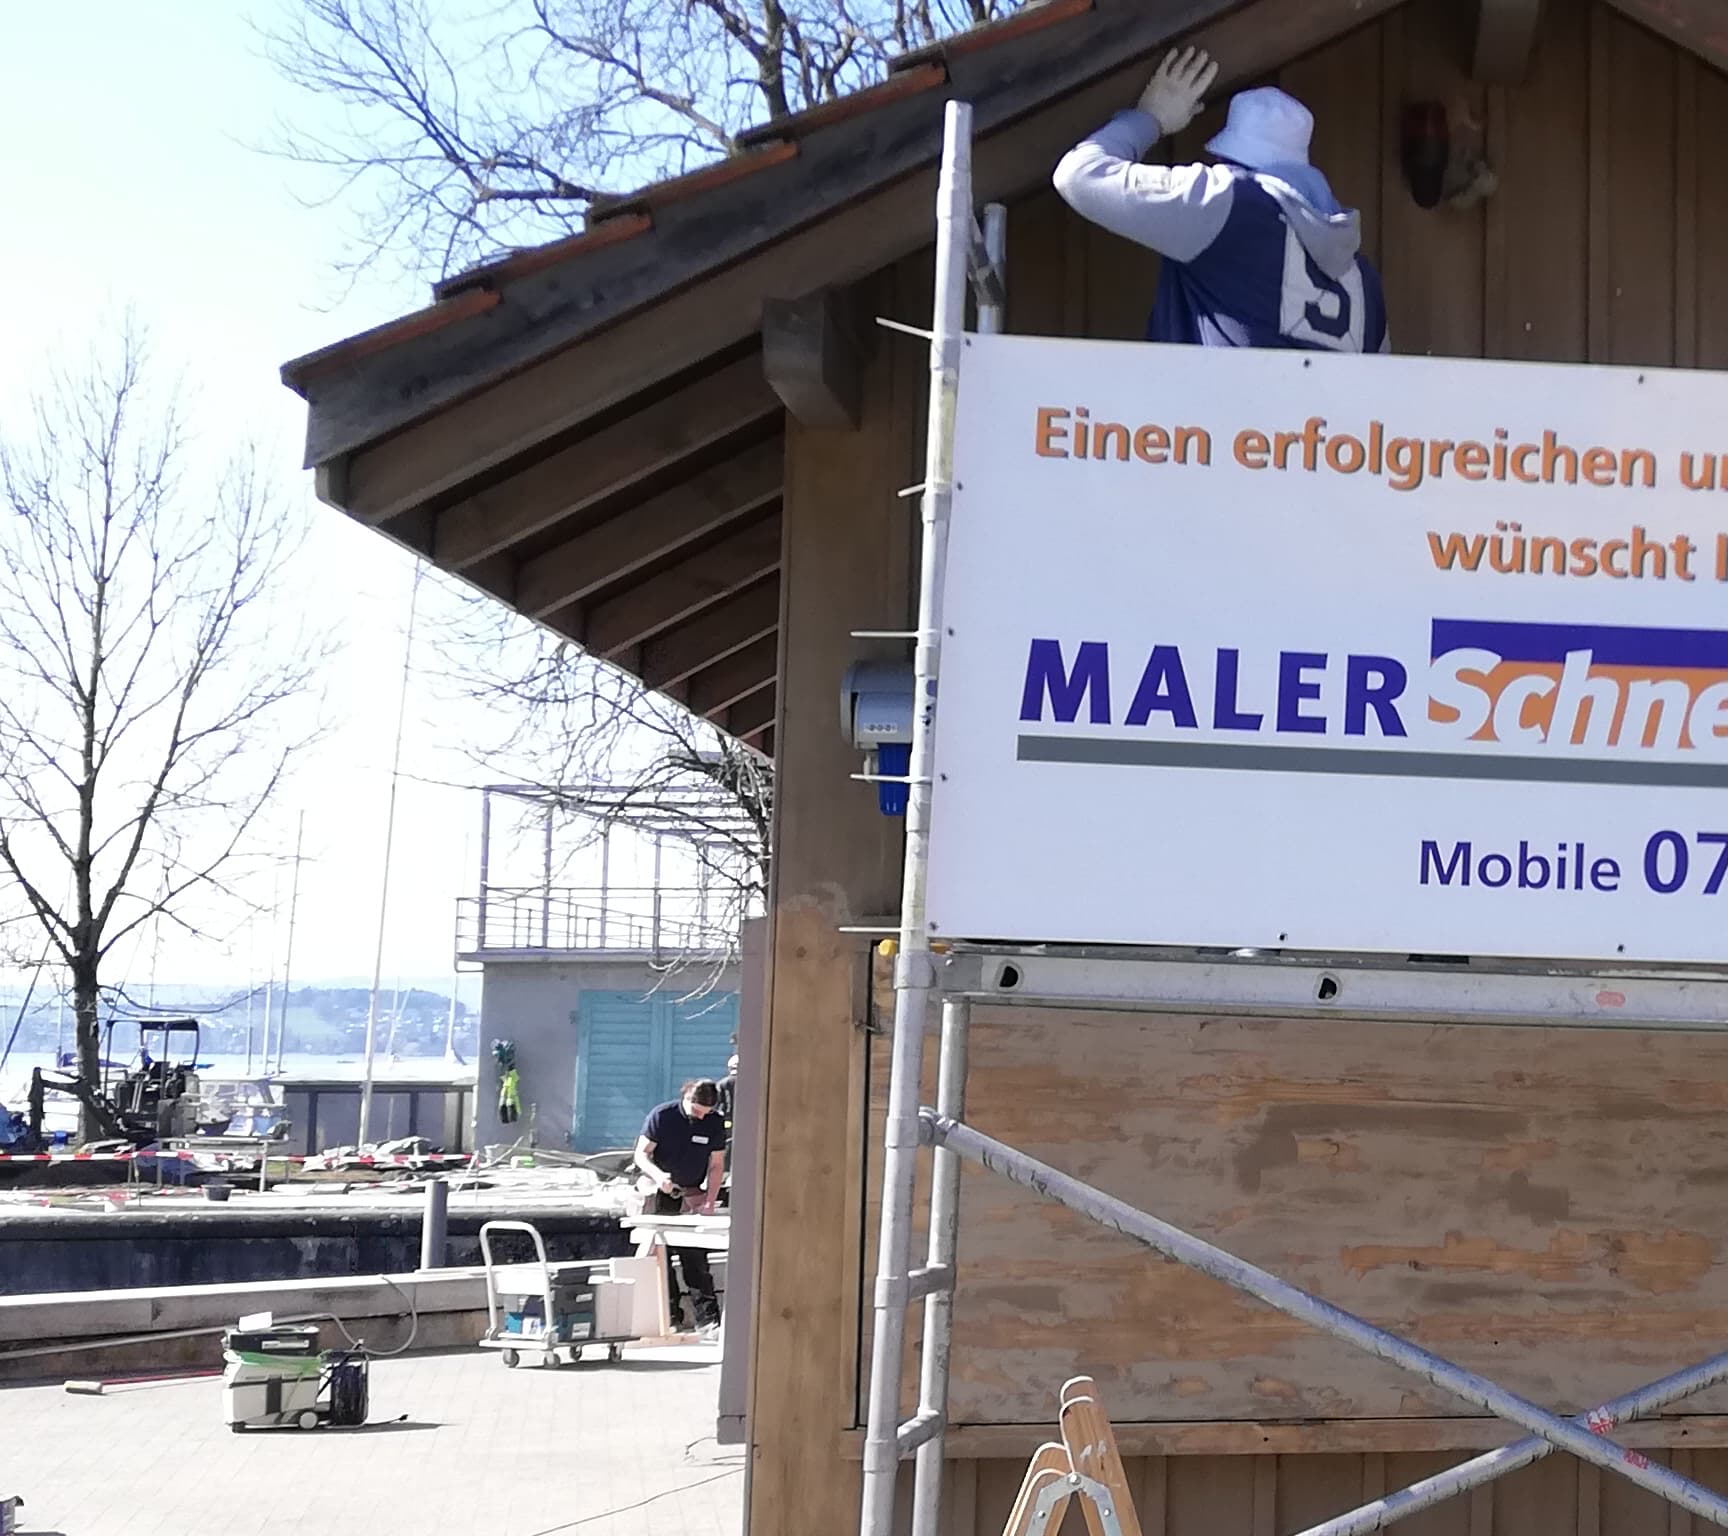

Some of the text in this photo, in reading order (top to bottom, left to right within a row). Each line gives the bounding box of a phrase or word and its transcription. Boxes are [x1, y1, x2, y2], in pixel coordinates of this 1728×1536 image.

[1034, 406, 1211, 465] Einen
[1232, 416, 1656, 491] erfolgreichen
[1427, 521, 1697, 581] wünscht
[1019, 638, 1408, 737] MALER
[1418, 840, 1621, 892] Mobile
